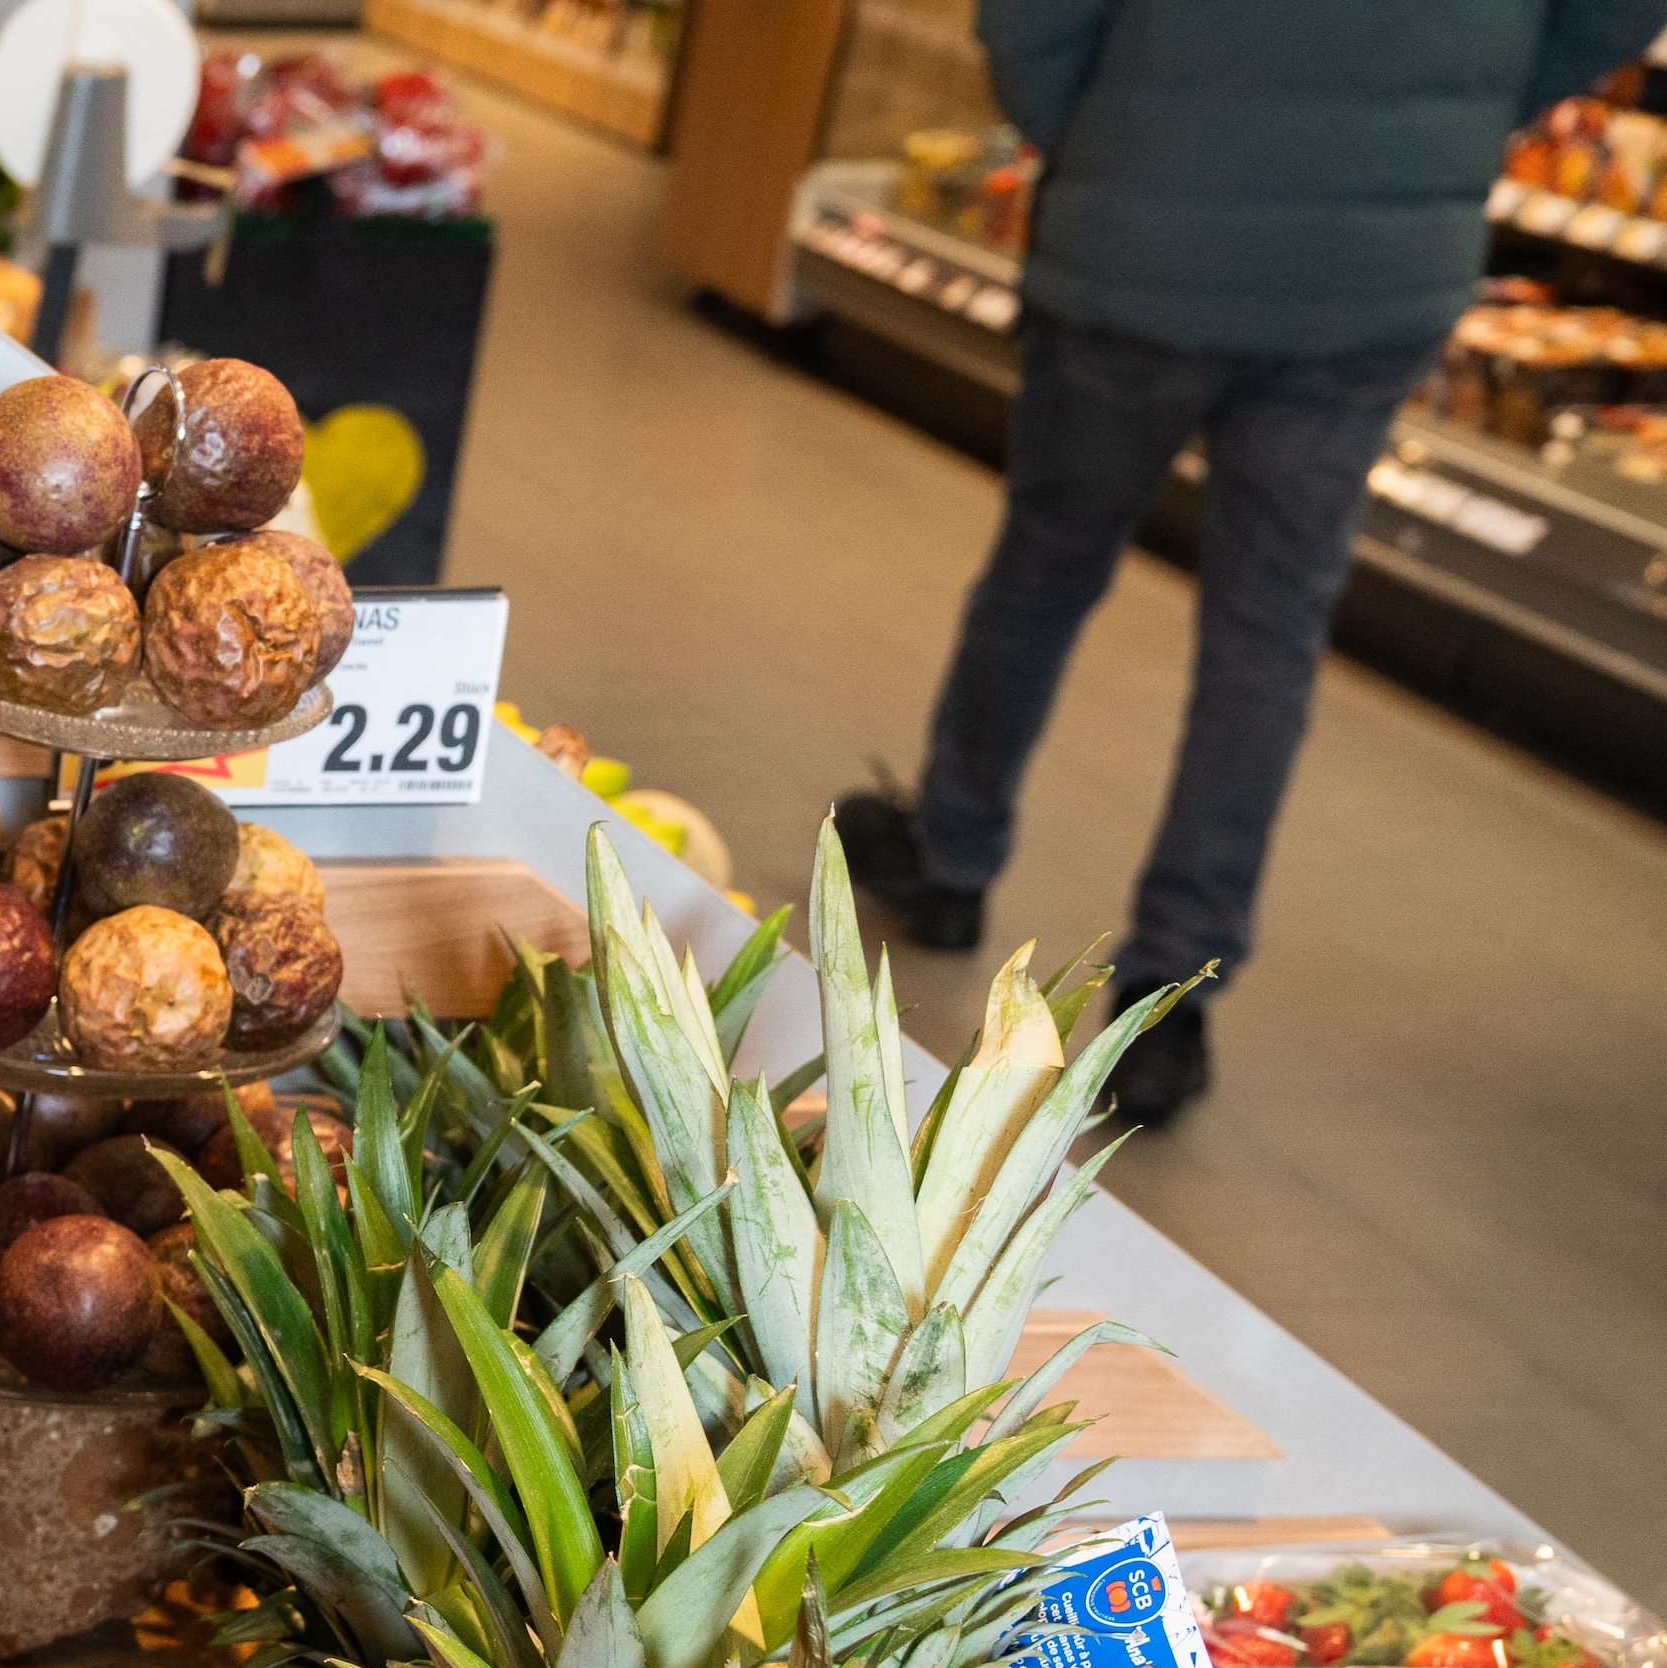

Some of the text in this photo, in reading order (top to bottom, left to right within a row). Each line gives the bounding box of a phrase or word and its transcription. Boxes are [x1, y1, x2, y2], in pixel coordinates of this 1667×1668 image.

[454, 680, 490, 696] Stück
[323, 703, 481, 773] 2.29
[1128, 1569, 1152, 1611] SCB
[1050, 1603, 1062, 1621] cet
[1047, 1640, 1058, 1655] de
